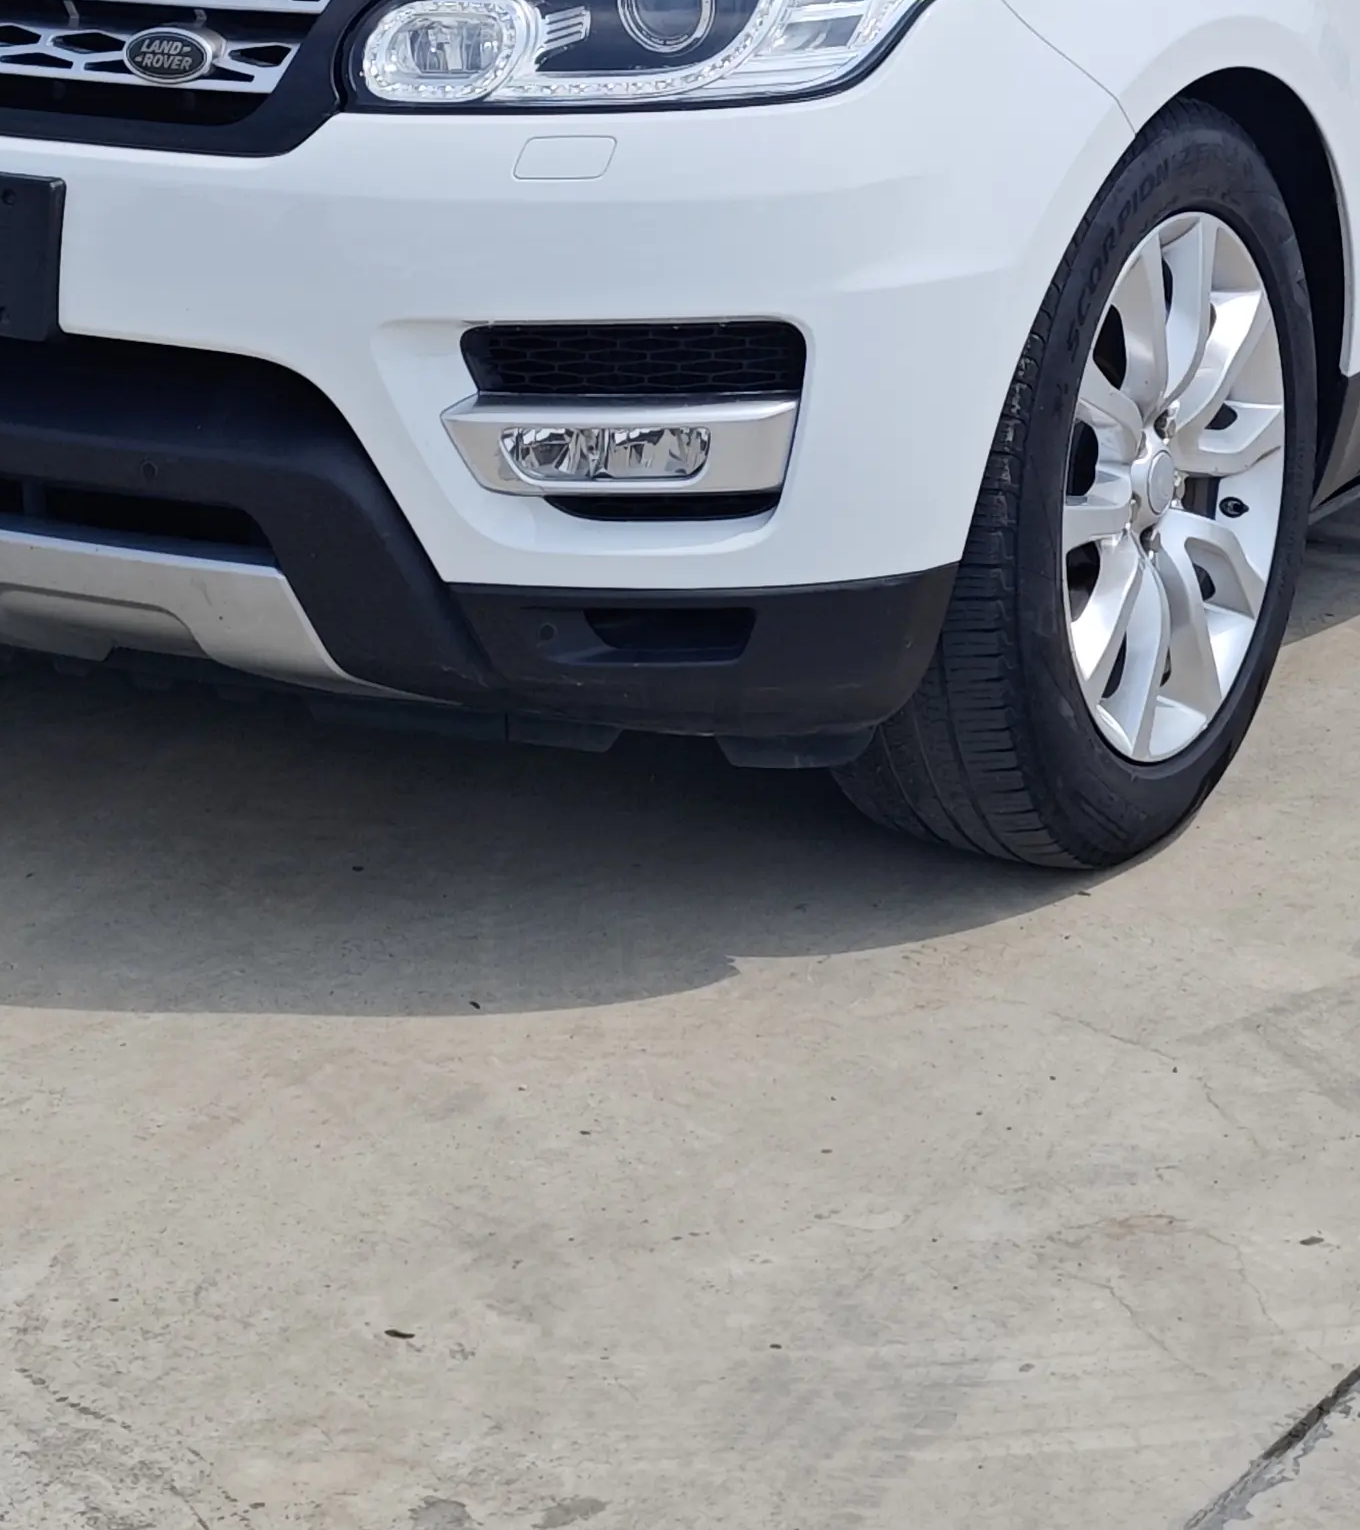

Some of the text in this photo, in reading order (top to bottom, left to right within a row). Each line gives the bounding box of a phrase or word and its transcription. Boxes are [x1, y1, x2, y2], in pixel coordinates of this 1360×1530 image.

[141, 40, 182, 54] LAND
[142, 55, 192, 70] ROVER
[1067, 155, 1170, 364] SCORPION
